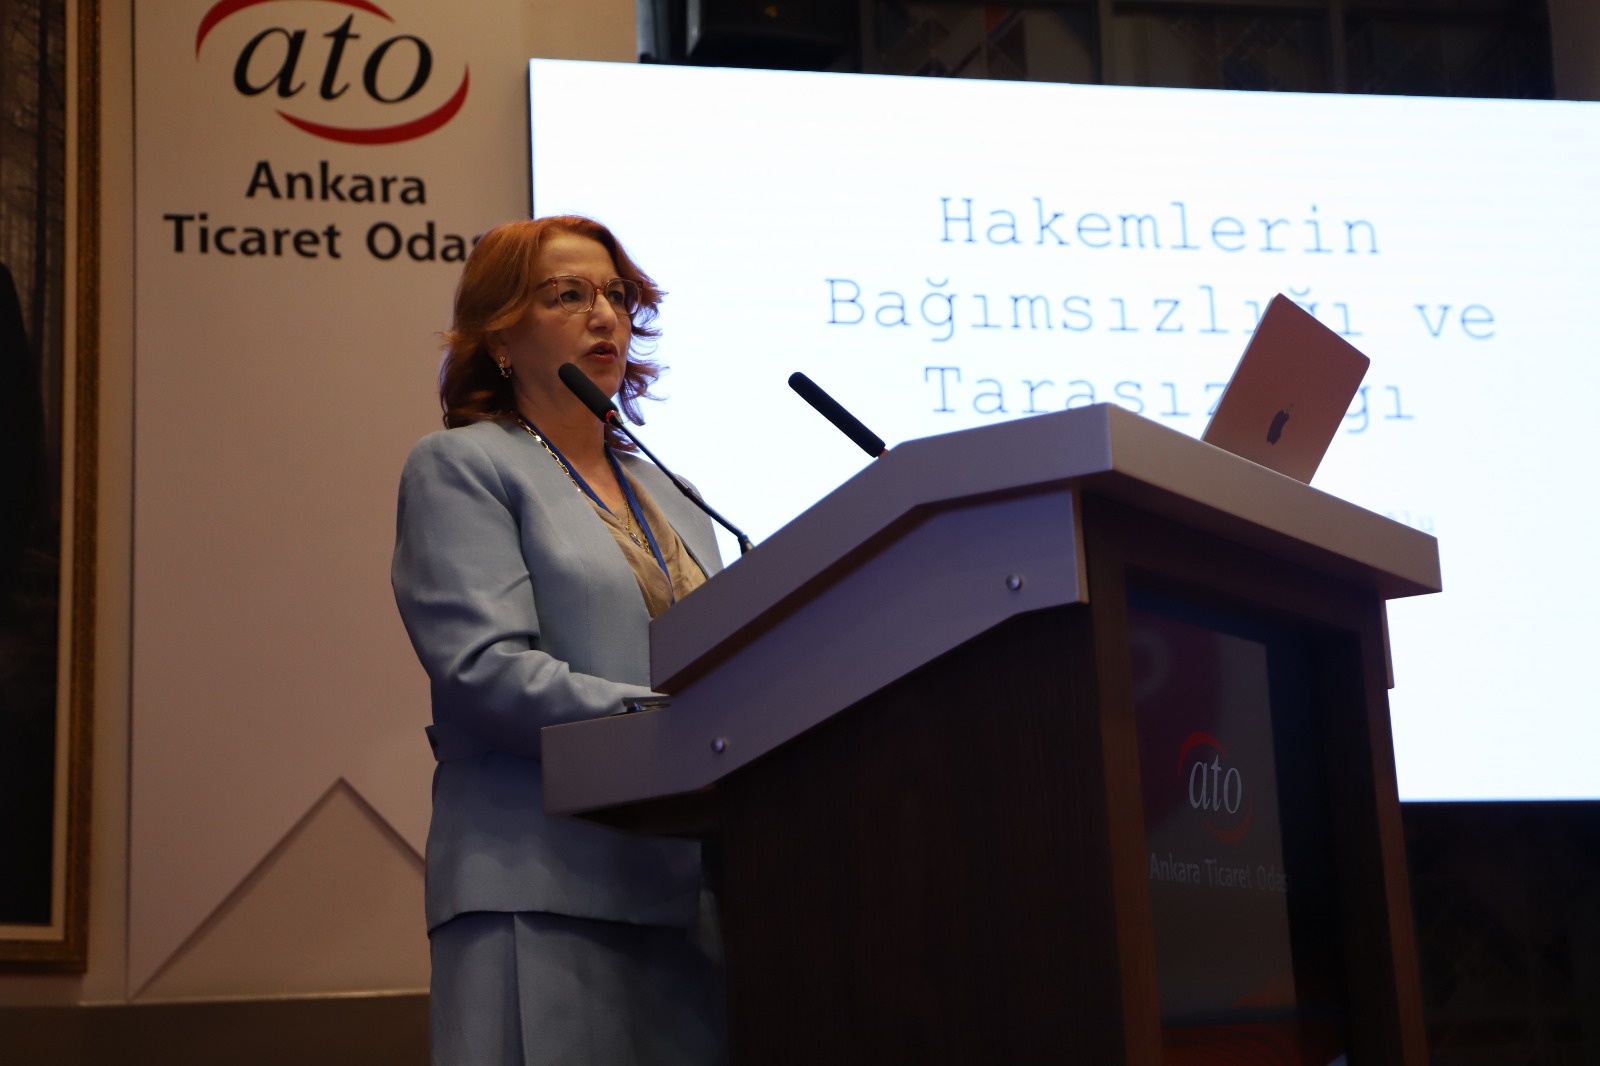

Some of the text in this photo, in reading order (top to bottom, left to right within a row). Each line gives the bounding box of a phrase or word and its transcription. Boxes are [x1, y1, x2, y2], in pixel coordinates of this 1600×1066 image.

[233, 13, 433, 104] ato
[246, 160, 426, 205] Ankara
[163, 212, 483, 262] Ticaret Oda
[940, 196, 1380, 255] Hakemlerin
[1414, 302, 1496, 340] ve
[1188, 754, 1243, 815] ato
[1149, 852, 1201, 884] Ankara
[1204, 857, 1253, 890] Ticaret
